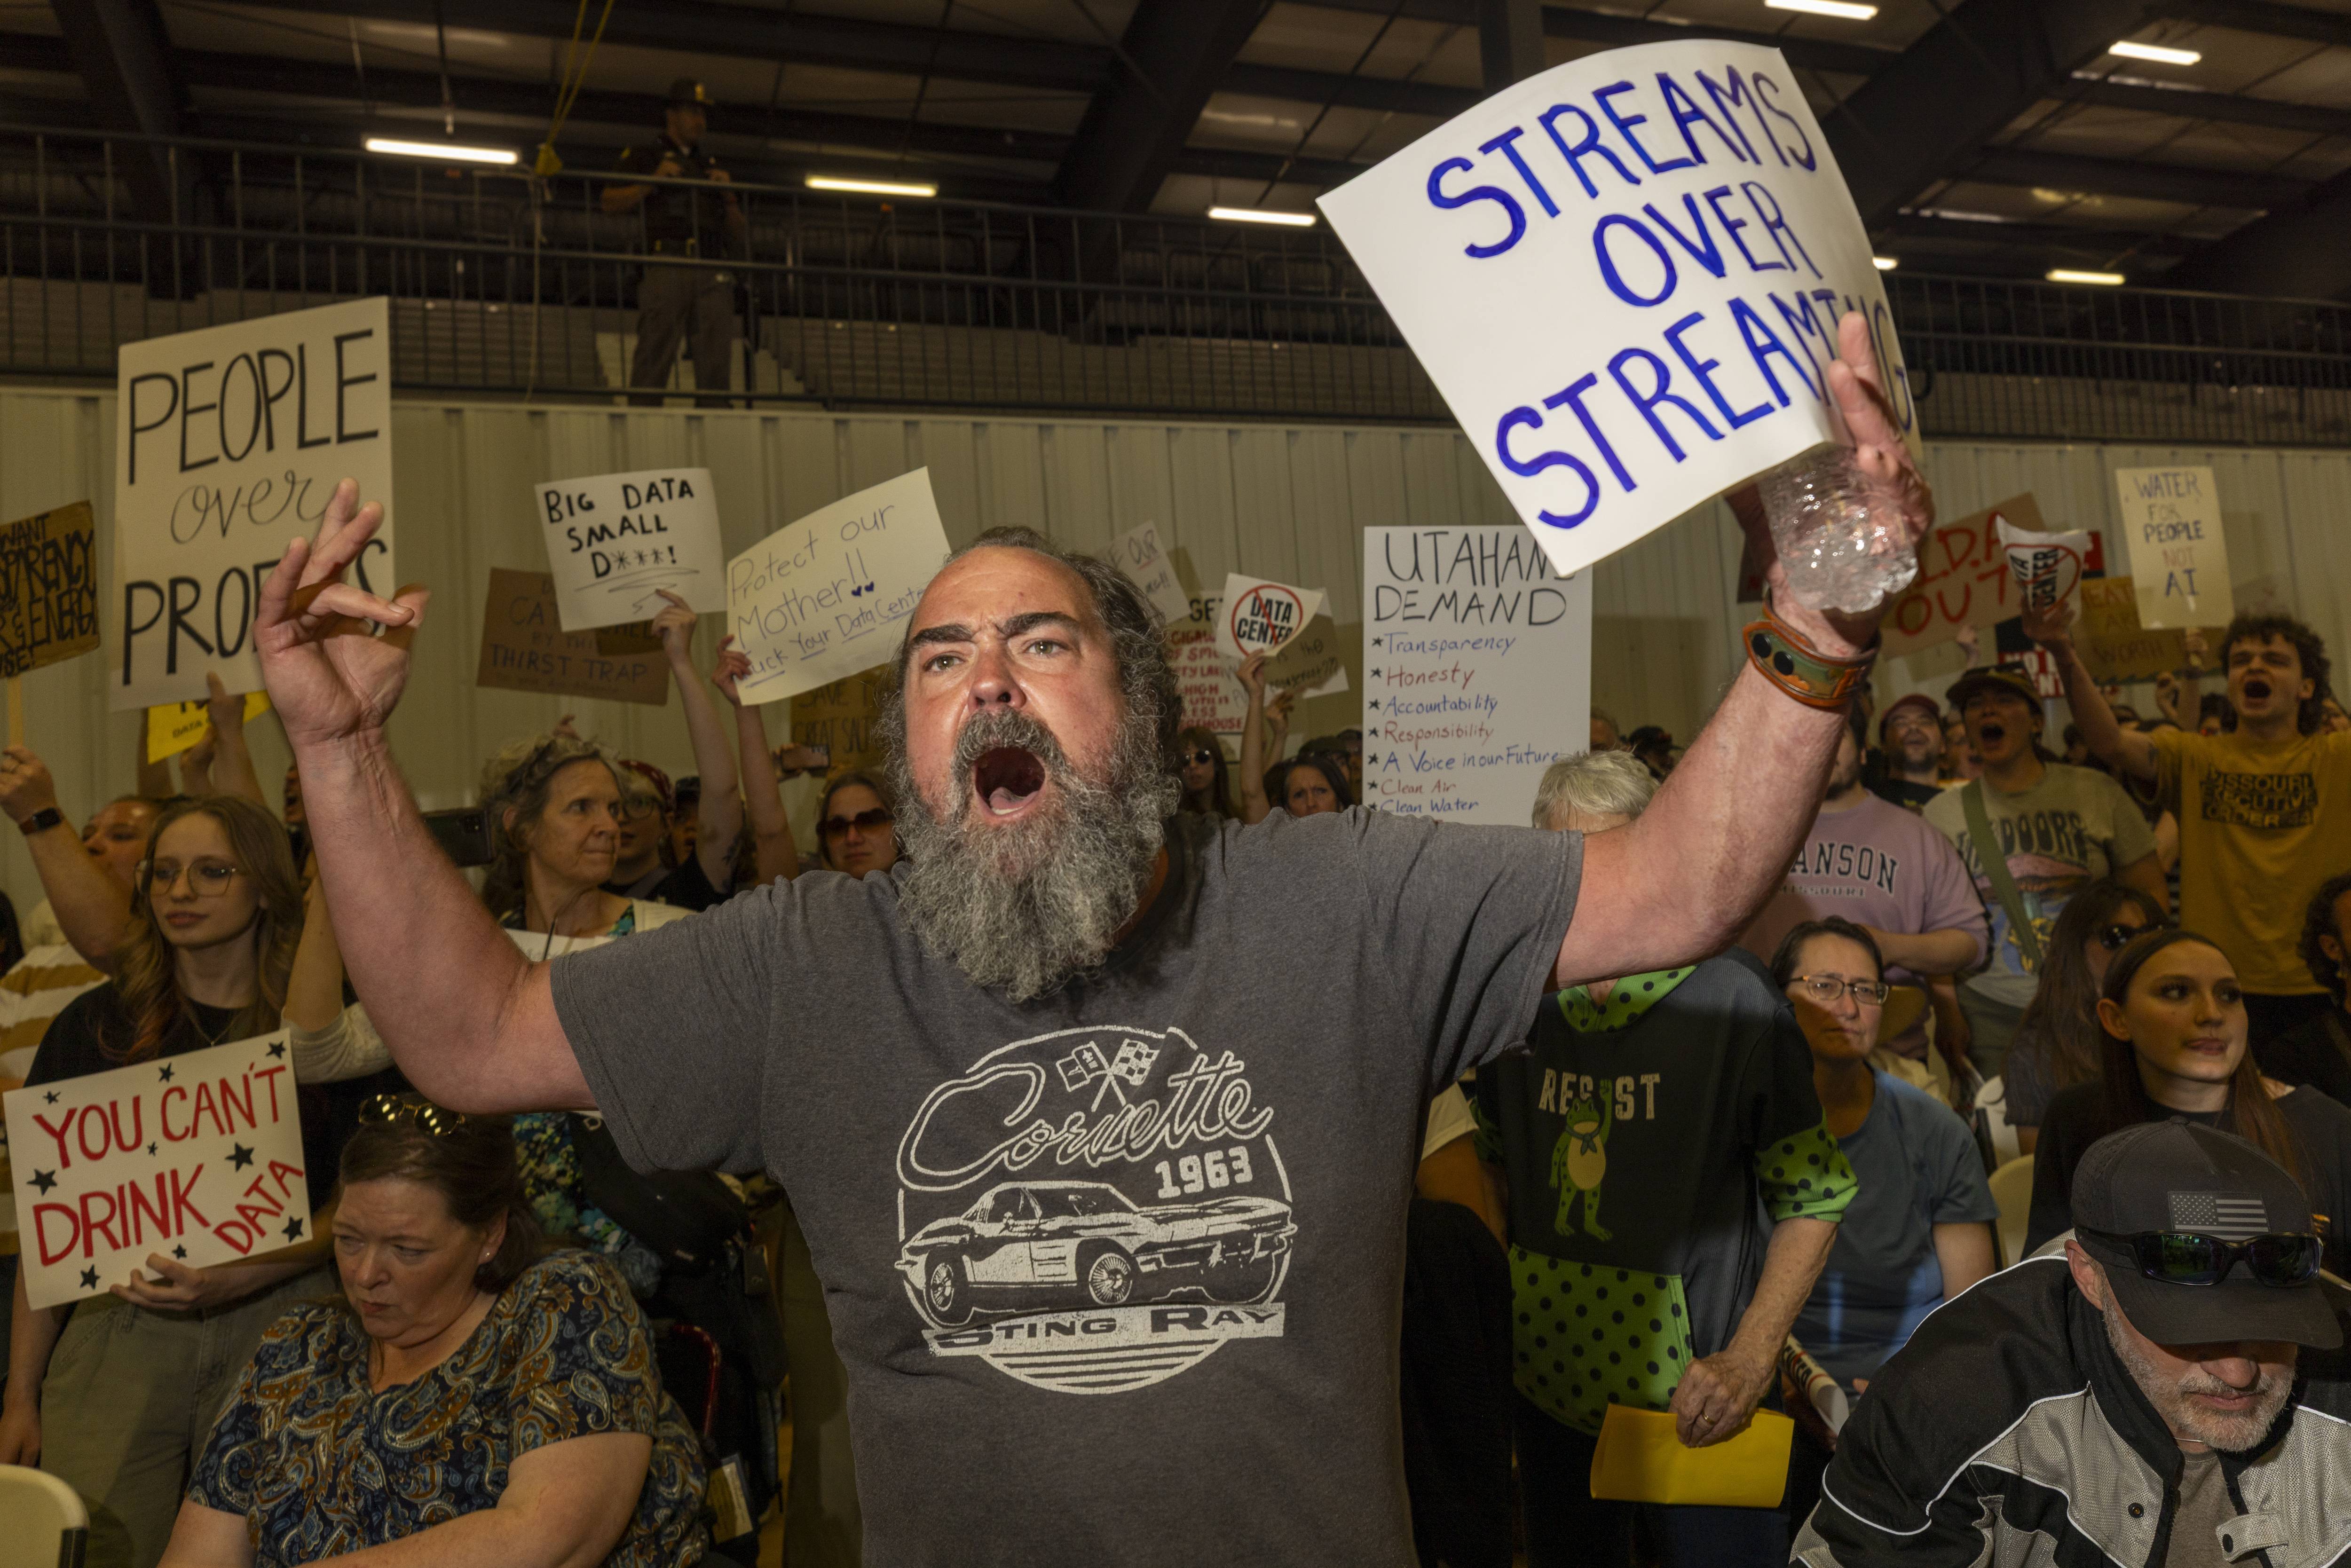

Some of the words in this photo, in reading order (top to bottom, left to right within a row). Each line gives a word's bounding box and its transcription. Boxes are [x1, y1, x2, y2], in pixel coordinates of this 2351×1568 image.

[1427, 64, 1817, 259] STREAMS
[1592, 181, 1823, 309] OVER
[128, 329, 379, 485] PEOPLE
[170, 469, 325, 544] over
[544, 489, 595, 524] BIG
[622, 477, 694, 511] DATA
[2132, 472, 2203, 498] WATER
[566, 513, 668, 553] SMALL
[729, 528, 819, 607] Protect
[841, 504, 895, 541] our
[2143, 520, 2205, 544] PEOPLE
[1385, 531, 1575, 589] UTAHAN
[2162, 546, 2195, 568] NOT
[1373, 584, 1567, 626] DEMAND
[1897, 563, 2009, 636] OUT
[2165, 567, 2199, 597] AI
[122, 537, 387, 686] PROFS
[789, 629, 831, 654] Your
[835, 607, 876, 638] Data
[876, 586, 925, 619] Cente
[1250, 595, 1293, 624] DATA
[489, 643, 572, 676] THIRST
[583, 658, 648, 683] TRAP
[1384, 631, 1516, 659] Transparency
[1386, 661, 1475, 690] Honesty
[1382, 693, 1498, 718] Accountability
[1382, 751, 1401, 773] A
[1409, 750, 1456, 773] Voice
[1505, 742, 1559, 765] Future
[1384, 720, 1494, 751] Responsibility
[1380, 779, 1424, 796] Clean
[1431, 779, 1457, 794] Air
[1380, 799, 1422, 814] Clean
[1430, 798, 1480, 813] Water
[1999, 810, 2089, 866] DOORS
[1790, 843, 1897, 895] ANSON
[32, 1095, 142, 1169] YOU
[160, 1062, 286, 1142] CAN'T
[1538, 1067, 1660, 1121] RESST
[896, 1050, 1274, 1192] Corvette
[1154, 1145, 1254, 1199] 1963
[32, 1163, 211, 1267] DRINK
[212, 1159, 305, 1255] DATA
[1150, 1305, 1279, 1333] RAY
